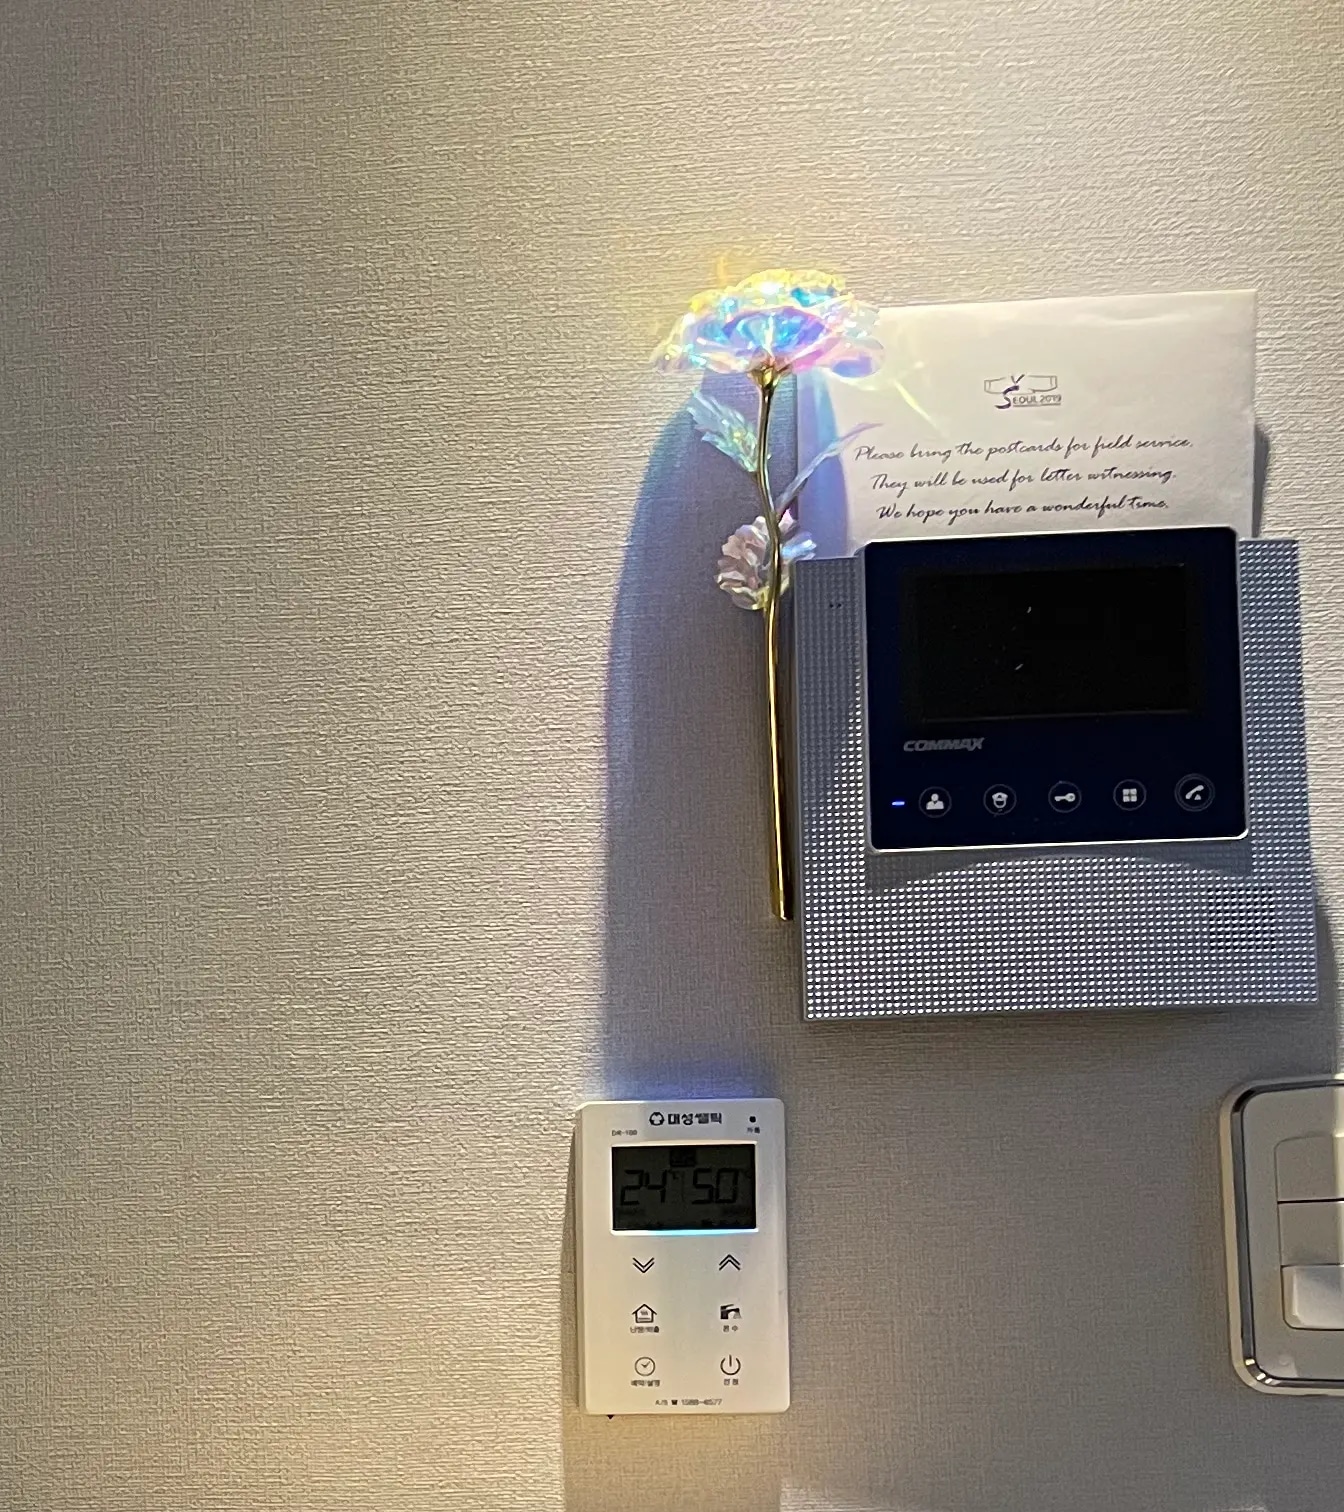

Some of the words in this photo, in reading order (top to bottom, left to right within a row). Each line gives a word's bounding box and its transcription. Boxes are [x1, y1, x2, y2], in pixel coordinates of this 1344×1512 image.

[855, 444, 905, 461] Please
[909, 443, 952, 464] bring
[955, 441, 984, 456] the
[986, 437, 1064, 461] postcards
[1064, 436, 1091, 460] for
[1091, 434, 1134, 459] field
[1135, 434, 1194, 450] service.
[870, 473, 909, 498] They
[913, 471, 948, 488] will
[951, 470, 969, 486] be
[972, 469, 1010, 485] used
[1009, 469, 1035, 492] for
[1040, 467, 1083, 482] letter
[1087, 466, 1177, 484] witnessing.
[875, 502, 903, 520] We
[906, 503, 944, 524] hope
[947, 507, 980, 526] you
[984, 499, 1023, 515] have
[1025, 505, 1038, 514] a
[1041, 494, 1128, 519] wonderful
[1127, 496, 1169, 510] time.
[903, 737, 986, 752] COMMAX
